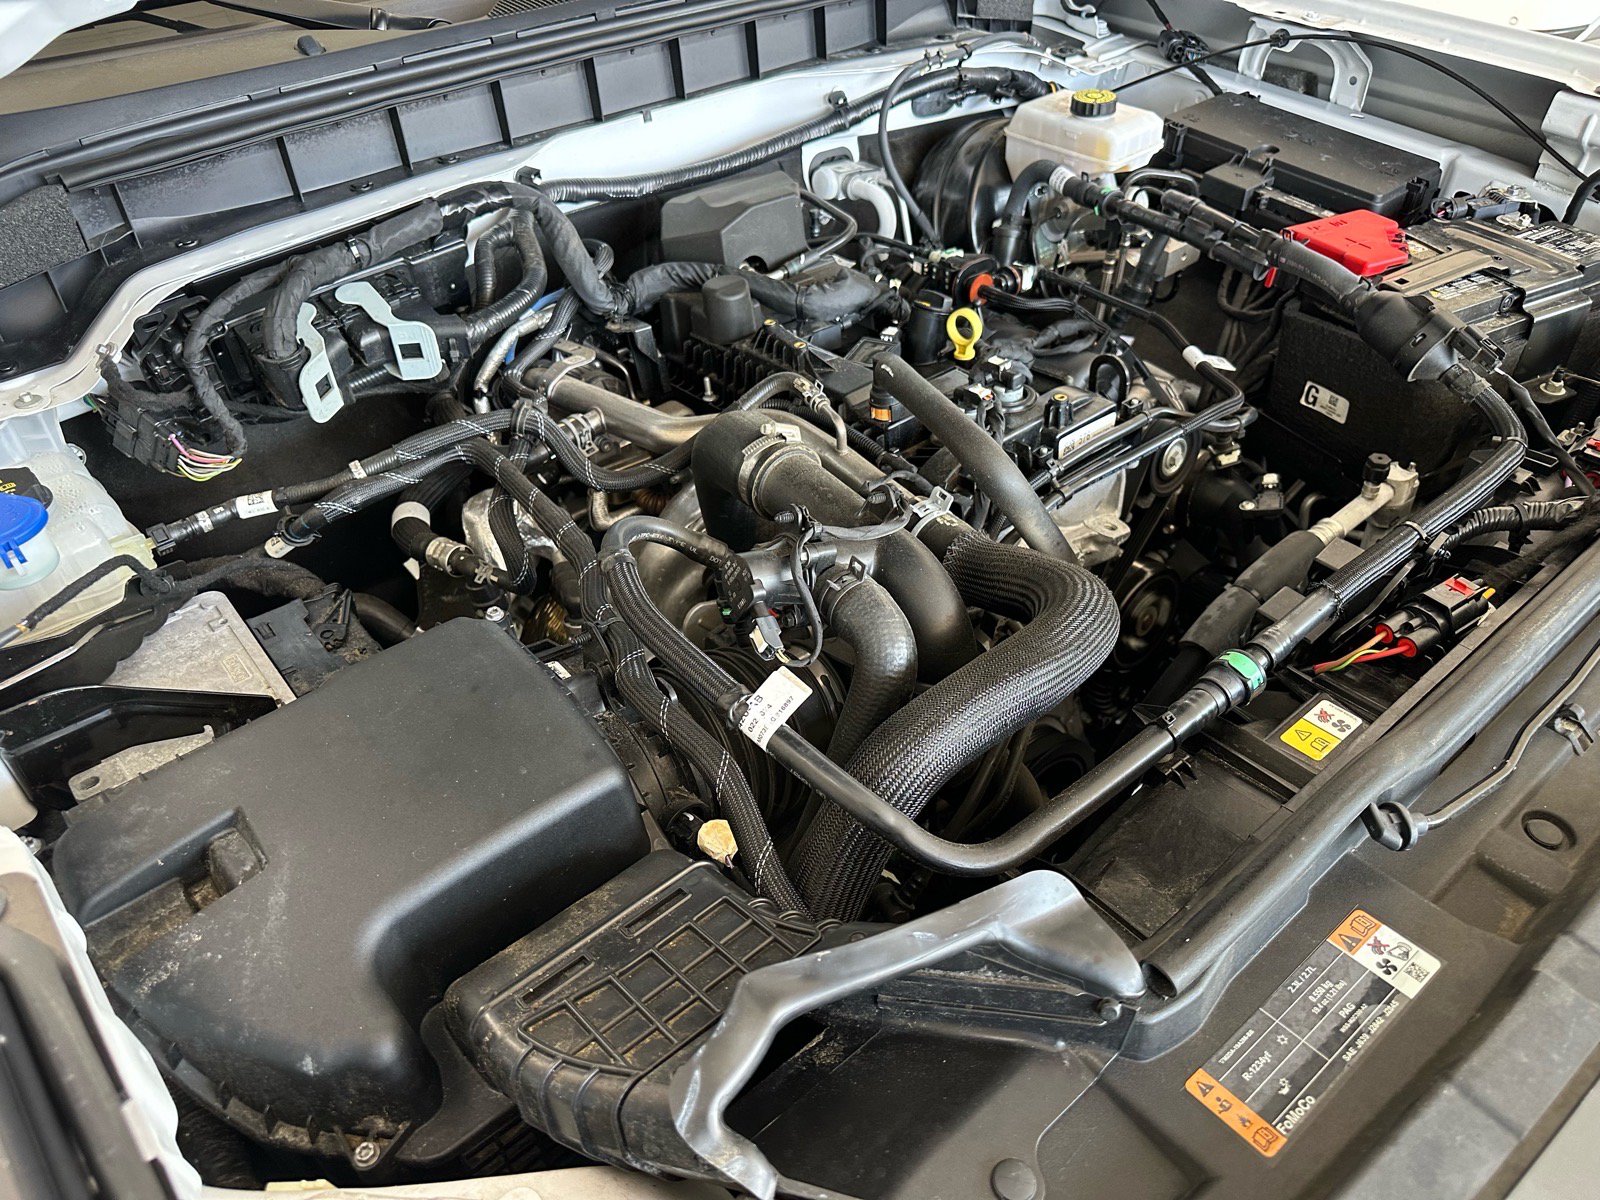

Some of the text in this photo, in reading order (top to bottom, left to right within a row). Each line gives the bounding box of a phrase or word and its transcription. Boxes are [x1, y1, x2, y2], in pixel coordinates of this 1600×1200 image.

[1304, 384, 1319, 407] G
[1338, 1002, 1356, 1019] PAG
[1241, 1050, 1272, 1081] R-1234yf
[1342, 1046, 1358, 1062] SAE
[1275, 1095, 1316, 1135] FoMoCo
